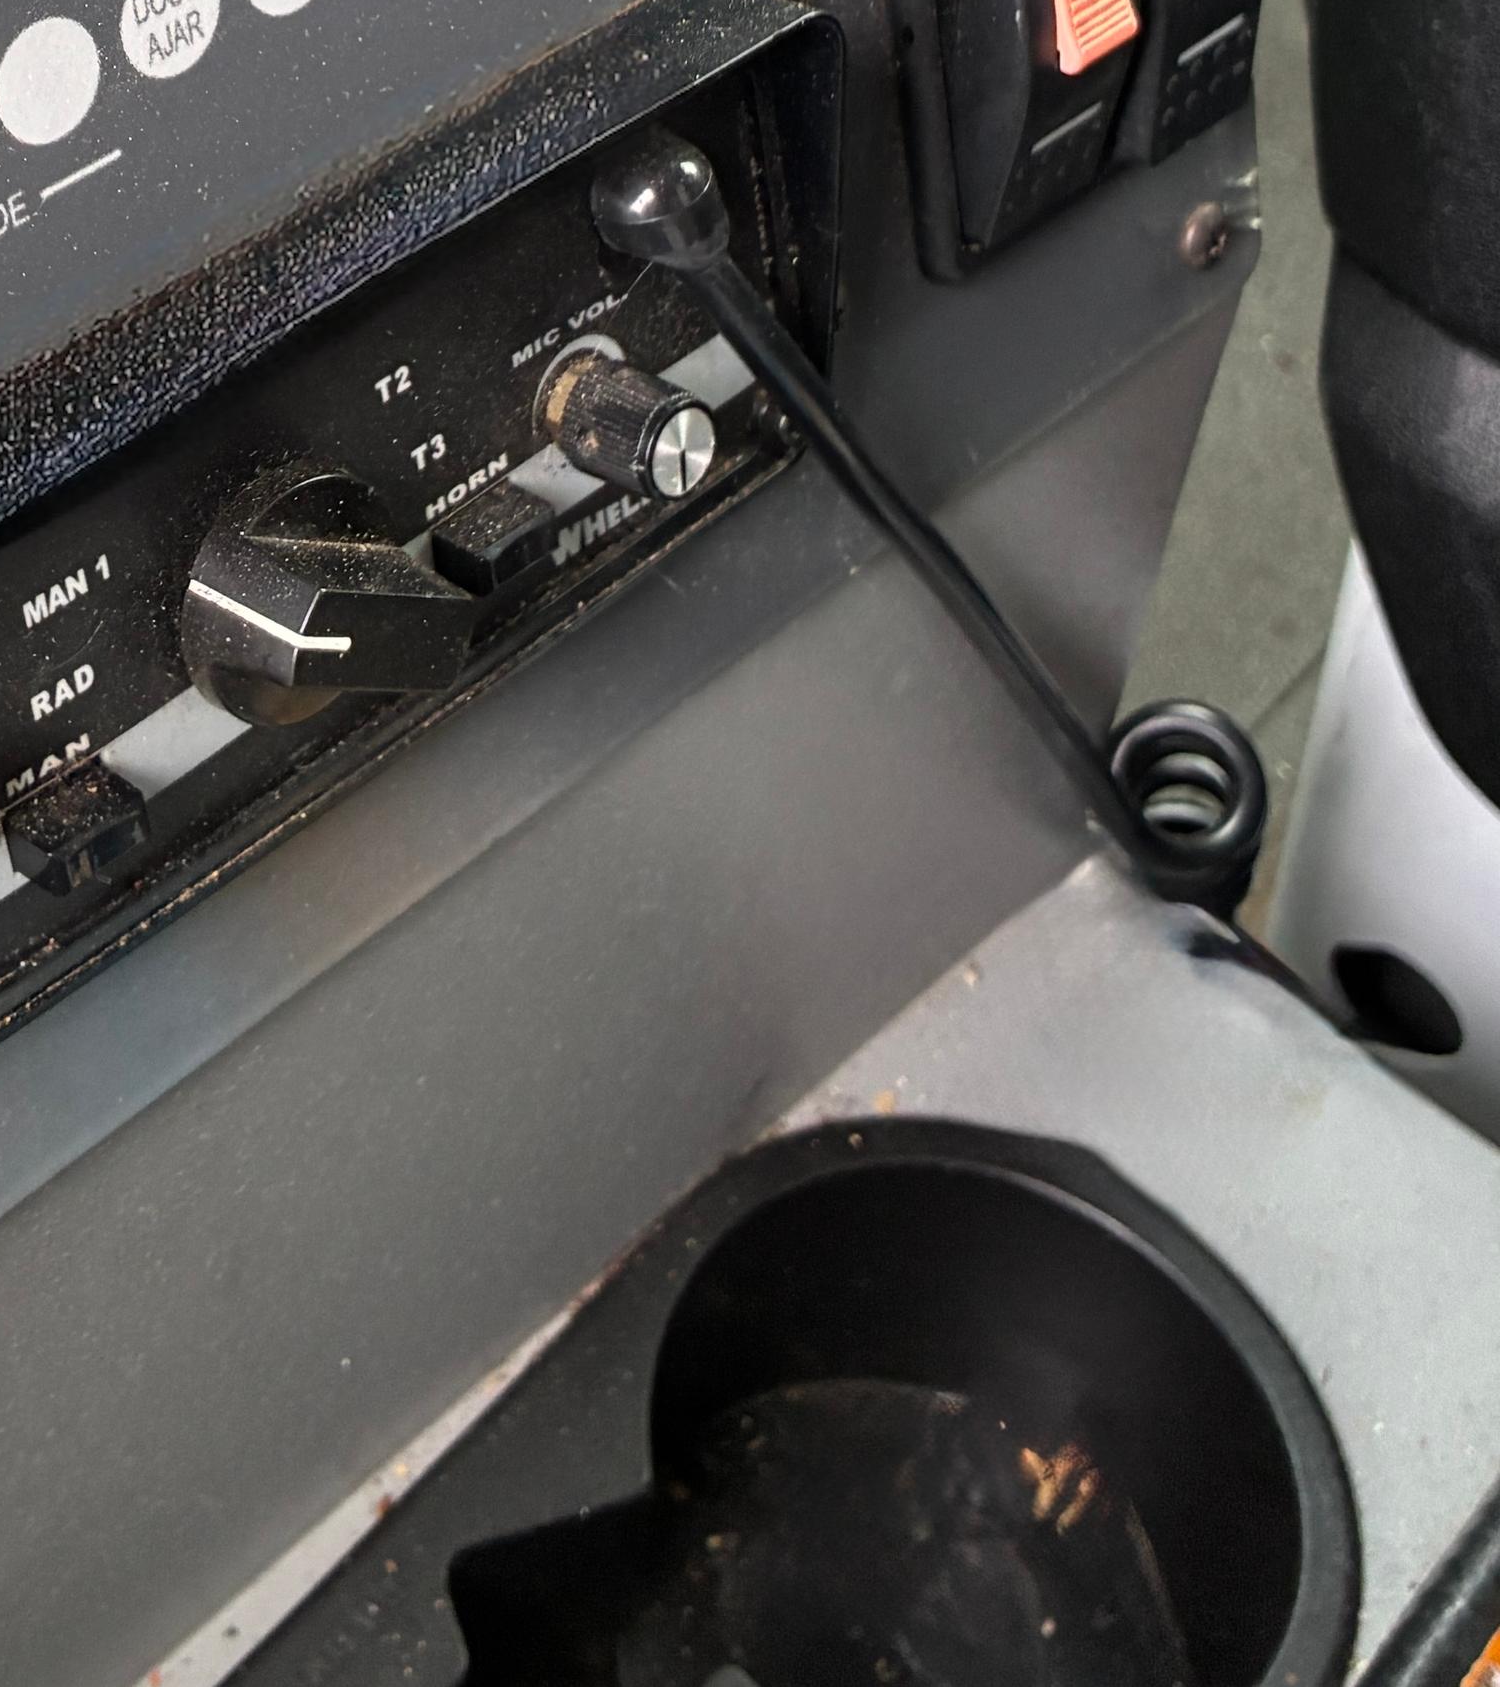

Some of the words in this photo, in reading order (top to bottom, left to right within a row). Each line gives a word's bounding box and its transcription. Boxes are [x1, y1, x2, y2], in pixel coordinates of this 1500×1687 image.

[147, 10, 205, 64] AJAR
[511, 327, 560, 368] MIC
[373, 365, 412, 404] T2
[409, 433, 447, 471] T3
[424, 453, 509, 521] HORN
[551, 493, 651, 566] WHEL
[23, 566, 89, 628] MAN
[94, 553, 112, 582] 1
[30, 662, 95, 720] RAD
[5, 732, 91, 799] MAN
